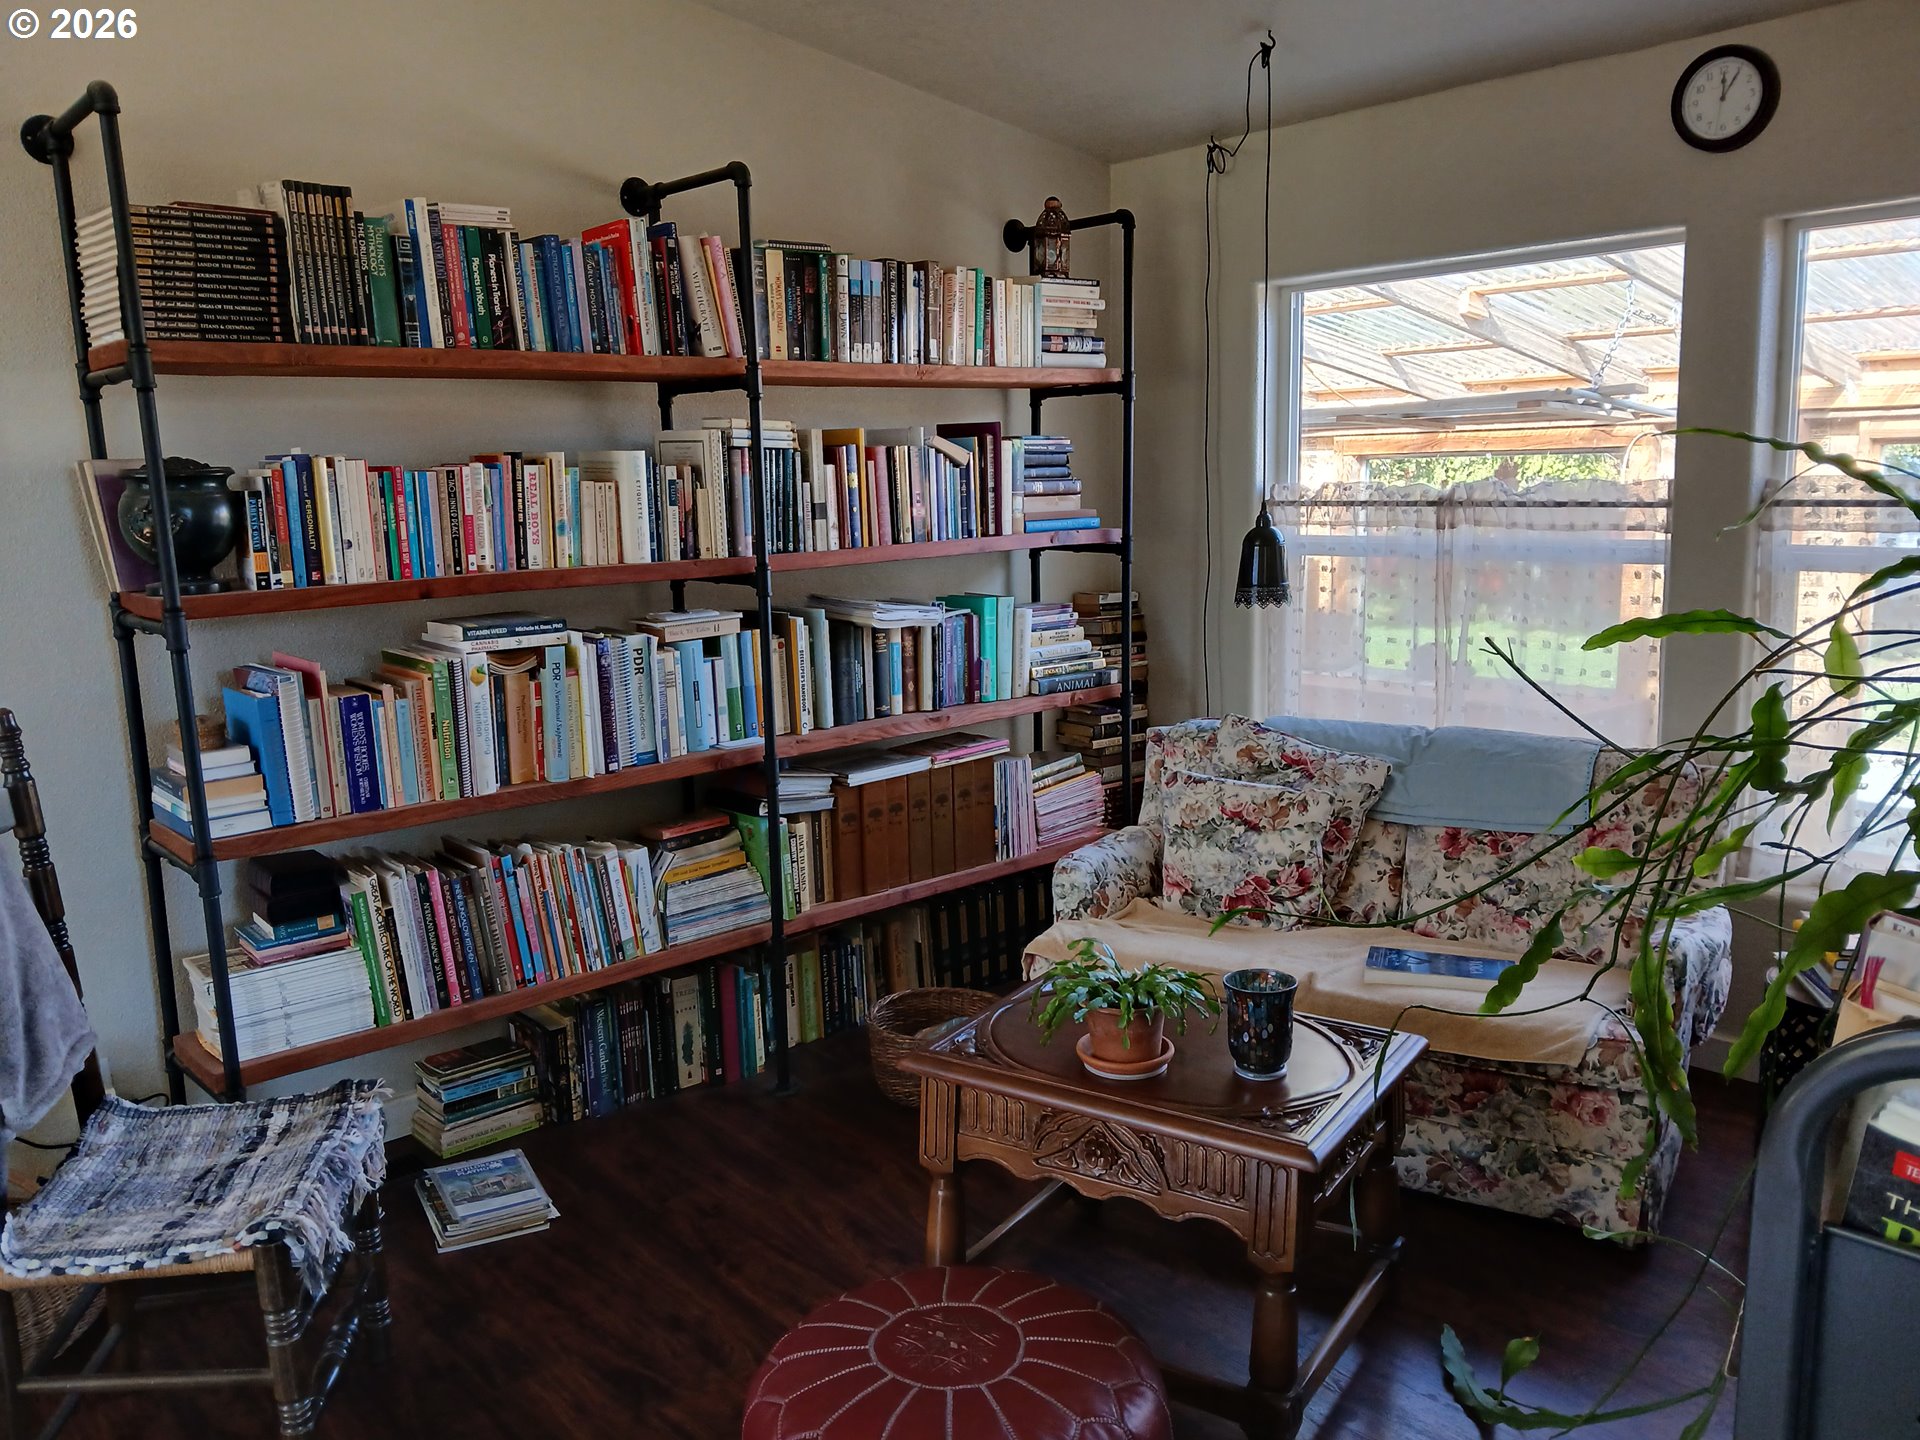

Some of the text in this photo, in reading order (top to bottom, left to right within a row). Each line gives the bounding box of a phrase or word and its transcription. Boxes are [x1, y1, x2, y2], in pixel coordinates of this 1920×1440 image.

[430, 213, 441, 240] MYTHIC
[358, 240, 368, 270] DRUIDS
[367, 225, 378, 276] MYTHOLOGY
[375, 227, 386, 277] BULFINCH'S
[431, 241, 446, 280] ASTROLOGY
[551, 249, 559, 284] ASTROLOGY
[715, 244, 726, 279] WICCA
[471, 257, 480, 285] Planets
[476, 293, 486, 315] Youth
[488, 254, 496, 283] Planets
[493, 291, 502, 316] Transit
[511, 244, 528, 330] ASPECTS IN ASTROLOGY
[589, 289, 597, 316] HOUSES
[692, 271, 710, 333] WITCHCRAFT
[839, 312, 847, 338] DAWN
[449, 498, 457, 517] INNER
[528, 473, 538, 508] REAL
[635, 480, 643, 520] ETIQUETTE
[304, 499, 316, 550] PERSONALITY
[451, 518, 459, 538] PEACE
[531, 512, 539, 545] BOYS
[552, 662, 561, 681] PDR
[554, 689, 562, 722] Nutritional
[633, 648, 647, 740] PDR Herbal Medicines
[657, 684, 667, 721] ANTIBIOTICS
[349, 713, 360, 745] WOMEN'S
[356, 712, 367, 744] WOMEN'S
[417, 704, 426, 735] HEALTH
[473, 701, 482, 737] Nutrition
[481, 694, 491, 755] Understanding
[421, 738, 429, 769] ANSWER
[442, 720, 452, 759] Nutrition
[556, 723, 564, 758] Supplements
[443, 884, 454, 914] BUNGALOW
[614, 878, 629, 930] Building Green
[369, 878, 401, 1017] GREAT ARCHITECTURE OF THE WORLD
[457, 901, 470, 937] BUNGALOW
[465, 938, 475, 964] KITCHEN
[595, 1008, 610, 1096] Western Garden Book
